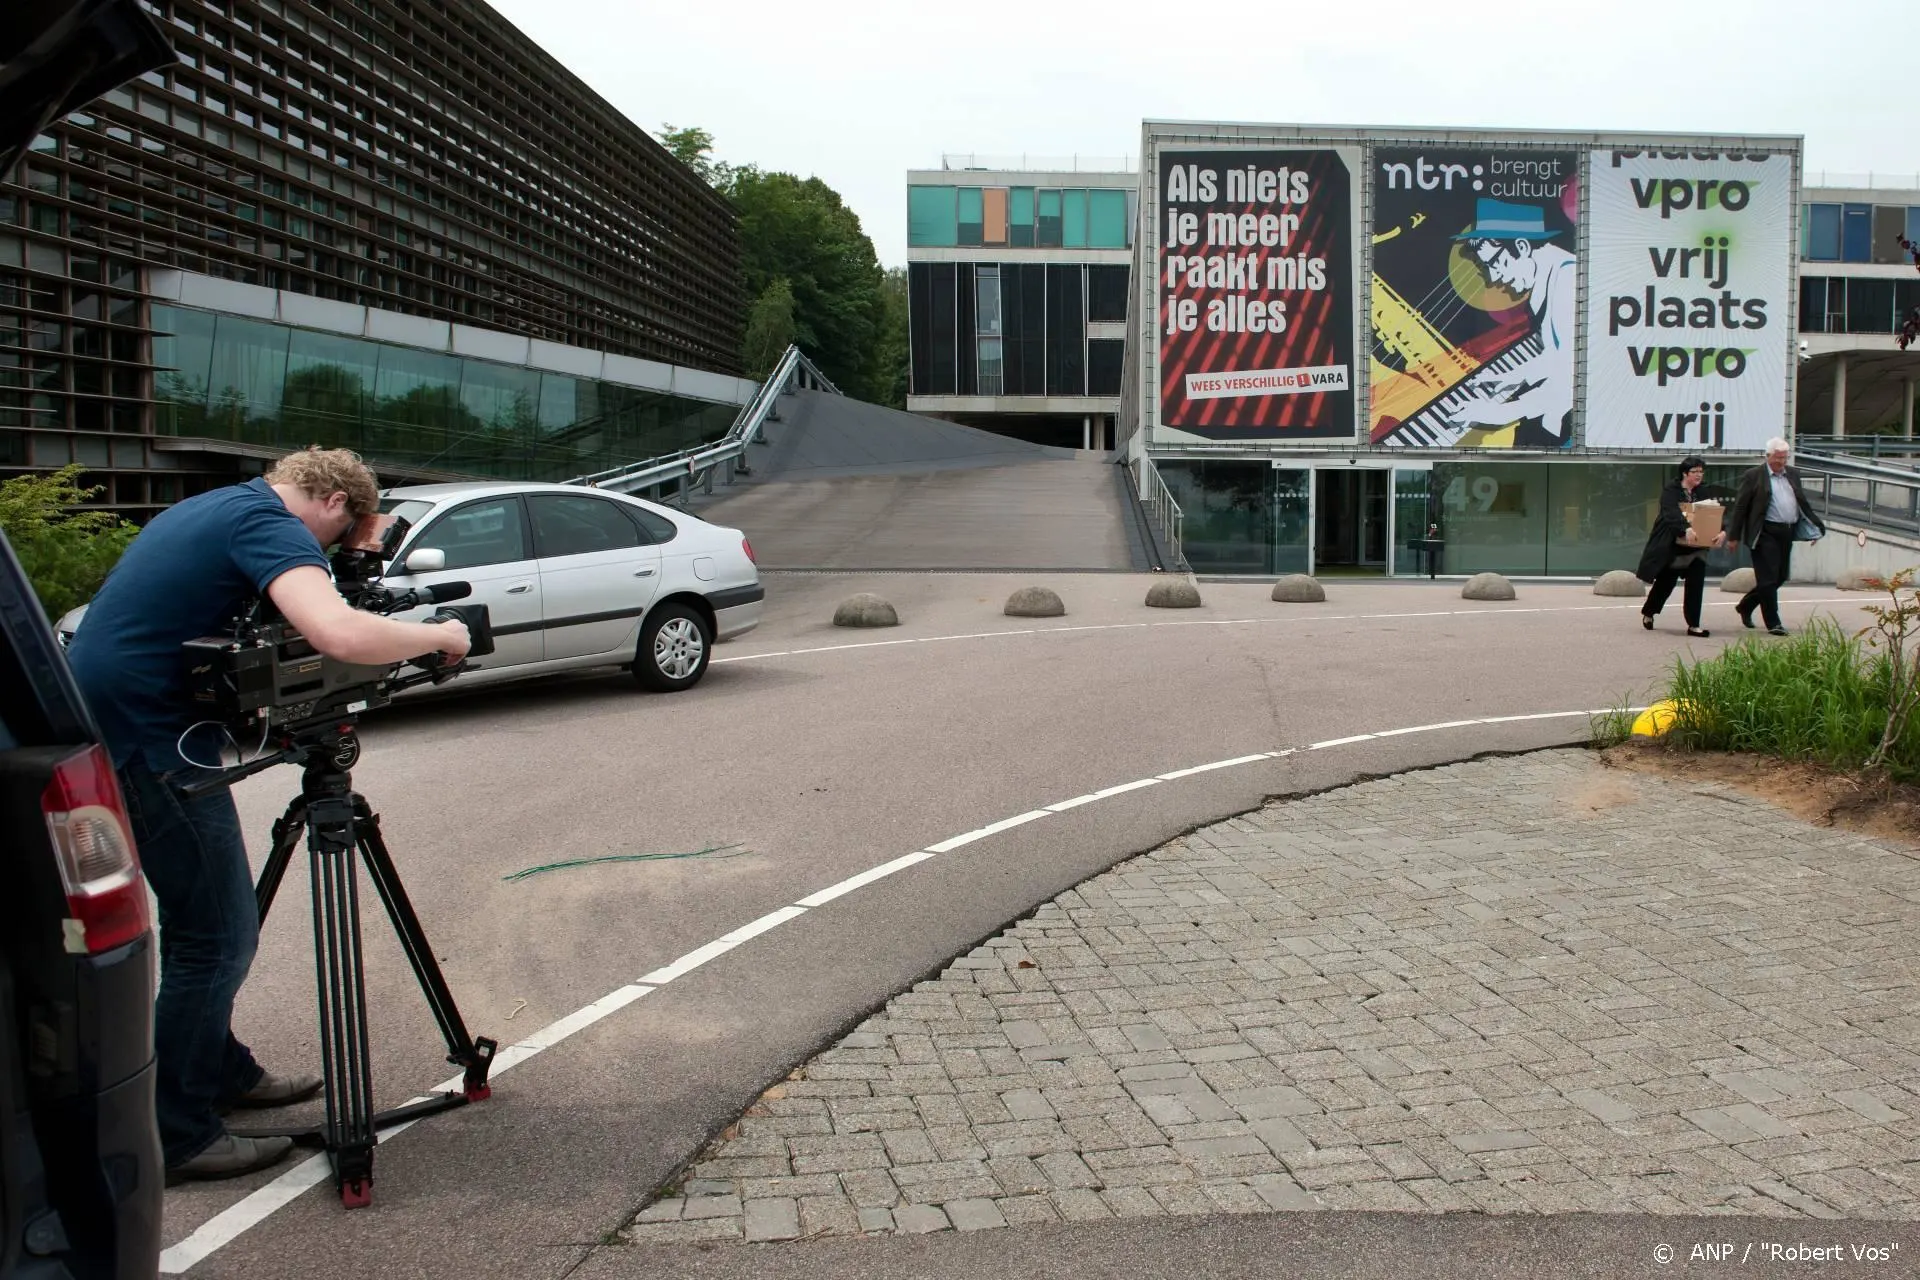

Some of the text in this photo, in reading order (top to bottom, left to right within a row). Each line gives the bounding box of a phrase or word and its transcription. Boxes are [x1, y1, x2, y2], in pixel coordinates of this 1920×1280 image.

[1167, 164, 1310, 204] Als niets
[1382, 156, 1484, 191] ntr:
[1491, 155, 1562, 180] brengt
[1491, 178, 1568, 198] cultuur
[1630, 177, 1750, 219] vpro
[1167, 208, 1300, 248] je meer
[1167, 252, 1327, 291] raakt mis
[1648, 236, 1729, 289] vrij
[1166, 295, 1287, 335] je alles
[1609, 285, 1768, 337] plaats
[1191, 380, 1222, 392] WEES
[1224, 376, 1294, 390] VERSCHILLIG
[1312, 373, 1344, 385] VARA
[1627, 346, 1746, 387] vpro
[1645, 401, 1725, 449] vrij
[1442, 476, 1499, 512] 49
